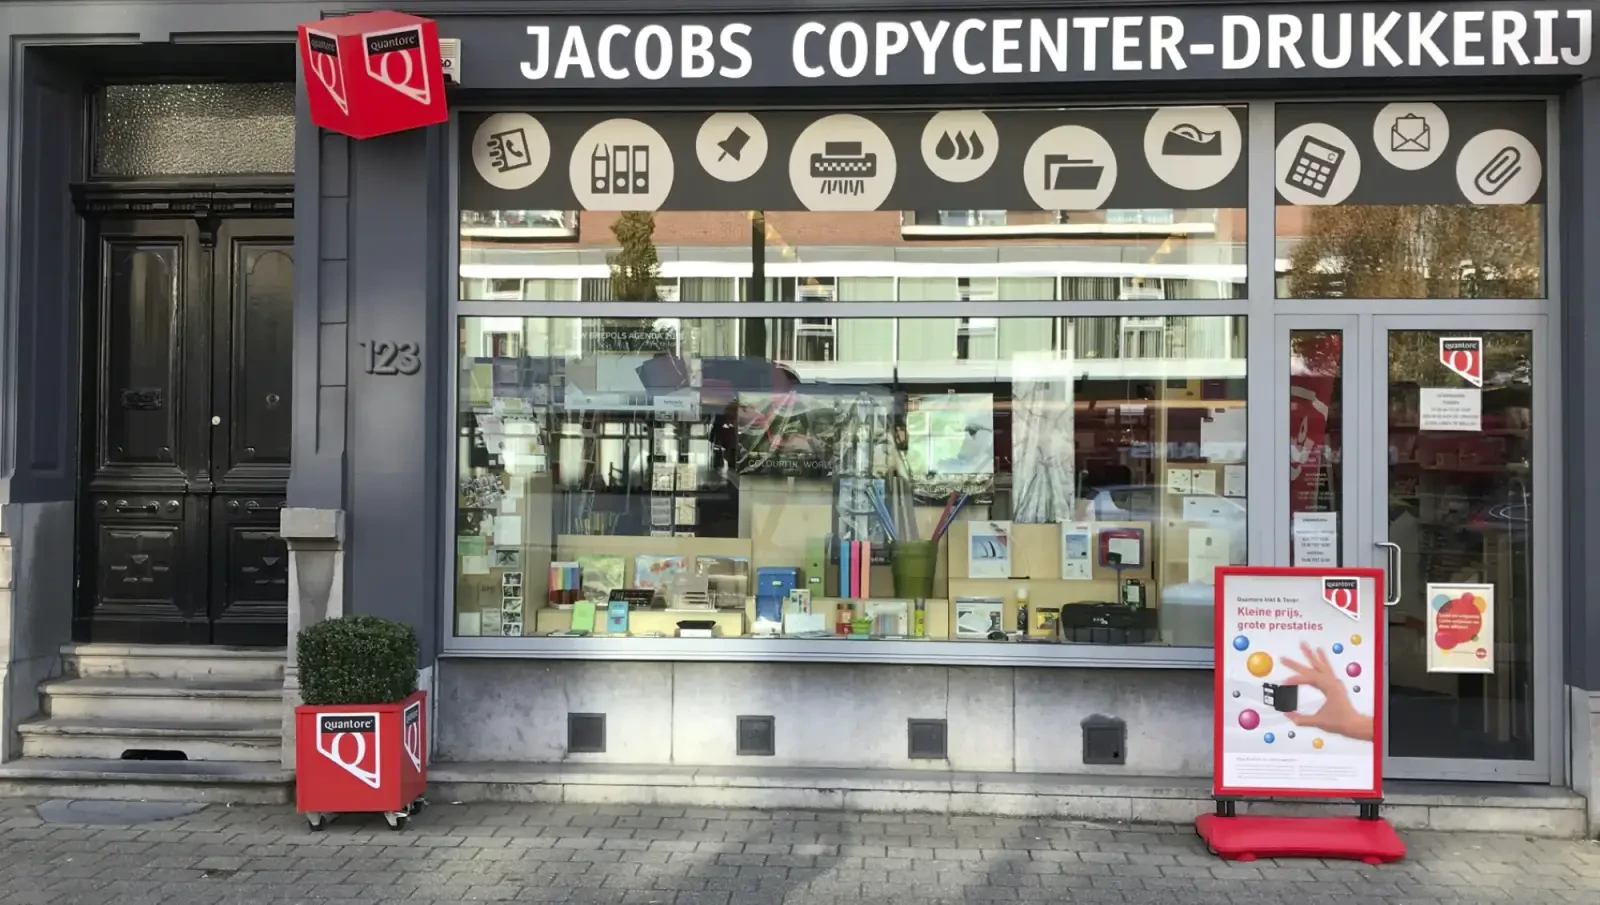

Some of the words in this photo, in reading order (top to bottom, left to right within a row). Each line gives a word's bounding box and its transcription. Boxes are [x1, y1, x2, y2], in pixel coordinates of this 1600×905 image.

[520, 23, 753, 81] JACOBS
[792, 9, 1592, 79] COPYCENTER-DRUKKERIJ
[359, 340, 421, 376] 123
[1237, 607, 1272, 617] Kleine
[1275, 607, 1303, 619] prijs,
[1237, 621, 1266, 631] grote
[1269, 621, 1323, 632] prestaties
